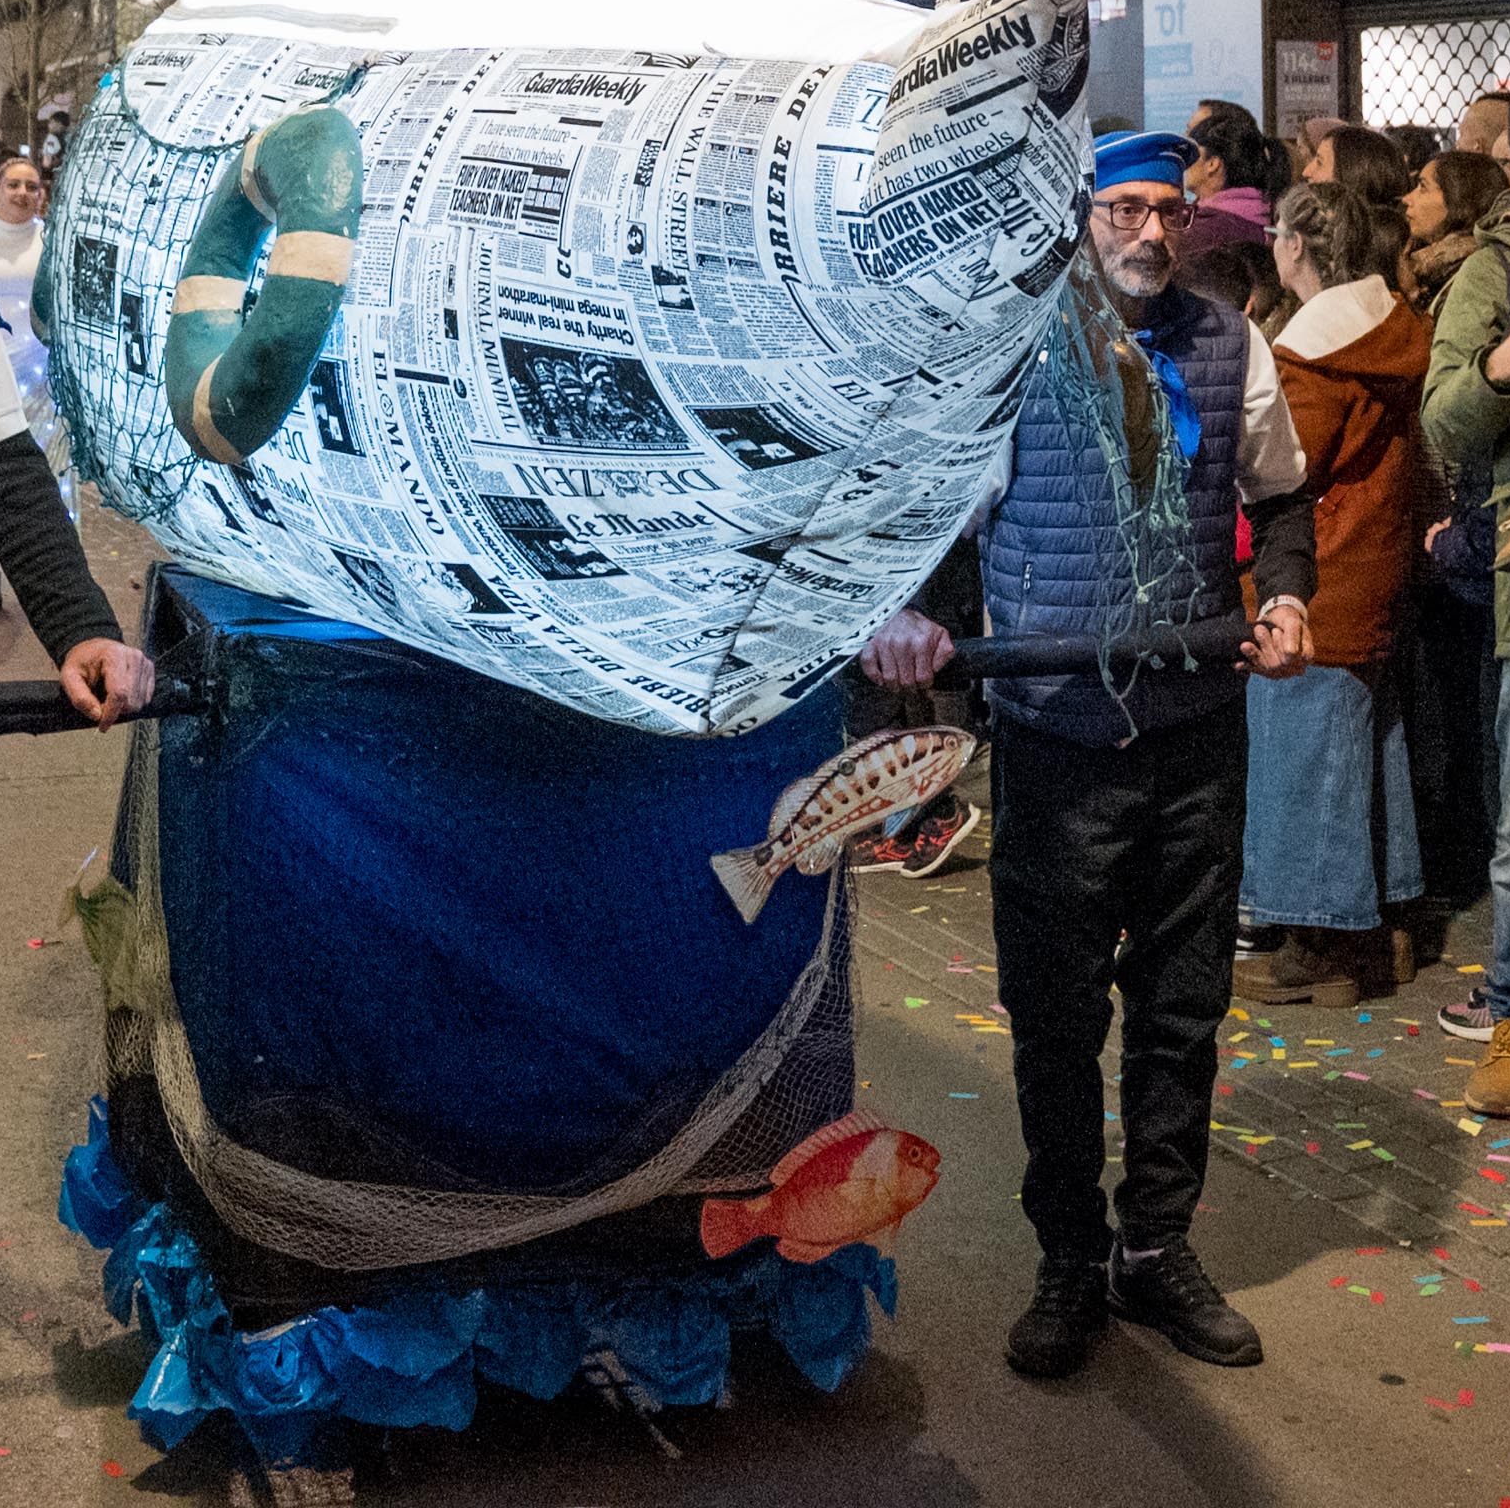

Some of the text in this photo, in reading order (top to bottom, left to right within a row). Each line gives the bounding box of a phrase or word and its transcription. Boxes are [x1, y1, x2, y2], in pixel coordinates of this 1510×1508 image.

[697, 79, 734, 120] THE
[671, 126, 705, 184] WALL
[878, 107, 991, 172] seen the future
[455, 163, 530, 195] FURY OVER NAKED
[885, 173, 915, 199] has
[914, 159, 949, 185] two
[949, 128, 1016, 170] wheels
[448, 187, 492, 216] TEACHERS
[878, 196, 926, 241] OVER
[920, 175, 984, 222] NAKED
[931, 212, 961, 246] ON
[960, 198, 1002, 234] NET
[497, 284, 628, 325] in mega mini-marathon
[497, 306, 635, 347] Charity the real winner
[477, 242, 521, 434] JOURNAL MUNDIAL
[489, 575, 542, 622] VIDA
[542, 623, 627, 674] DELLA
[780, 647, 842, 682] VIDA
